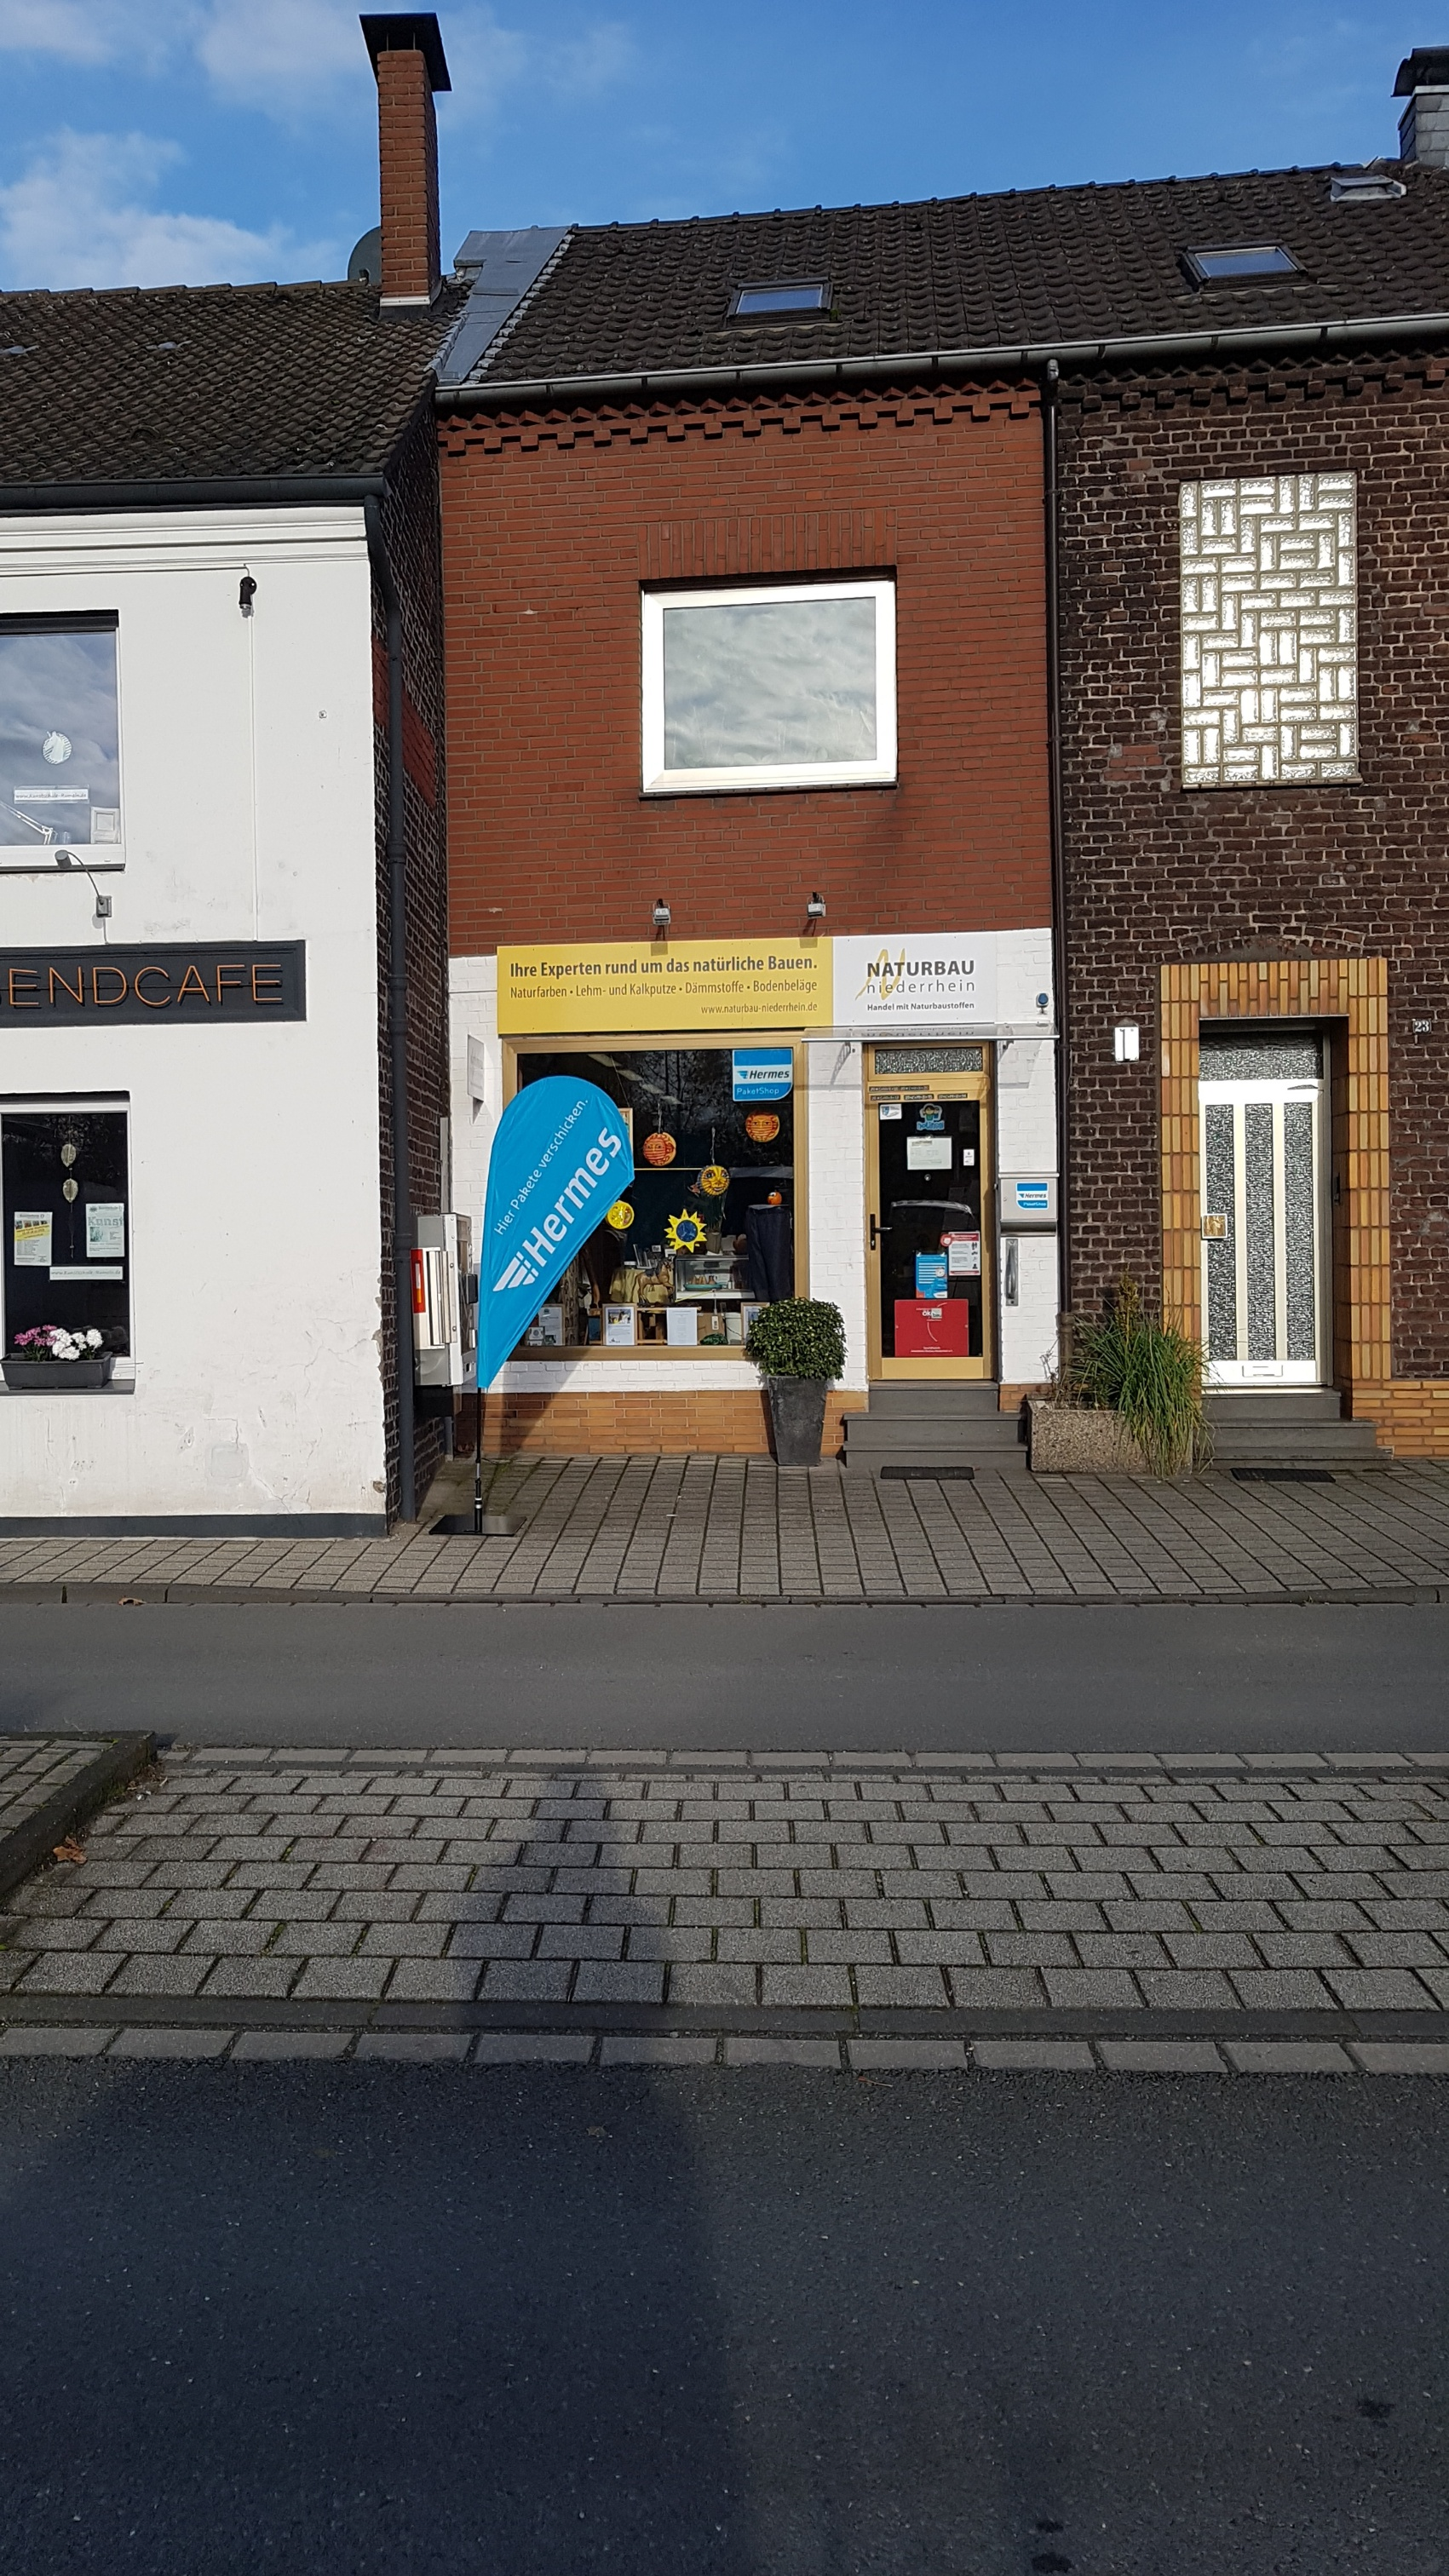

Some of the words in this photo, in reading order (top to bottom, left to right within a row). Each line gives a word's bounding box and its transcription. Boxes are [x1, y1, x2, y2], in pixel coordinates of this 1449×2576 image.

[510, 963, 538, 977] Ihre
[541, 961, 602, 979] Experten
[606, 959, 637, 974] rund
[641, 962, 663, 973] um
[666, 957, 690, 972] das
[693, 956, 765, 971] natürliche
[768, 956, 818, 970] Bauen.
[867, 960, 975, 977] NATURBAU
[510, 986, 567, 998] Naturfarben
[576, 984, 606, 997] Lehm-
[609, 984, 627, 995] und
[630, 982, 676, 997] Kalkputze
[685, 980, 745, 994] Dämmstoffe
[753, 980, 818, 993] Bodenbeläge
[866, 980, 975, 993] niederrhein
[701, 1003, 818, 1015] www.naturbau-niederrhein.de
[867, 1002, 894, 1011] Handel
[911, 1002, 975, 1010] Naturbaustoffen
[1414, 1021, 1429, 1032] 23
[750, 1070, 790, 1079] Hermes
[737, 1087, 779, 1095] PaketShop
[493, 1210, 516, 1236] Hier
[511, 1167, 543, 1210] Pakete
[539, 1099, 589, 1169] verschicken.
[521, 1126, 623, 1267] Hermes
